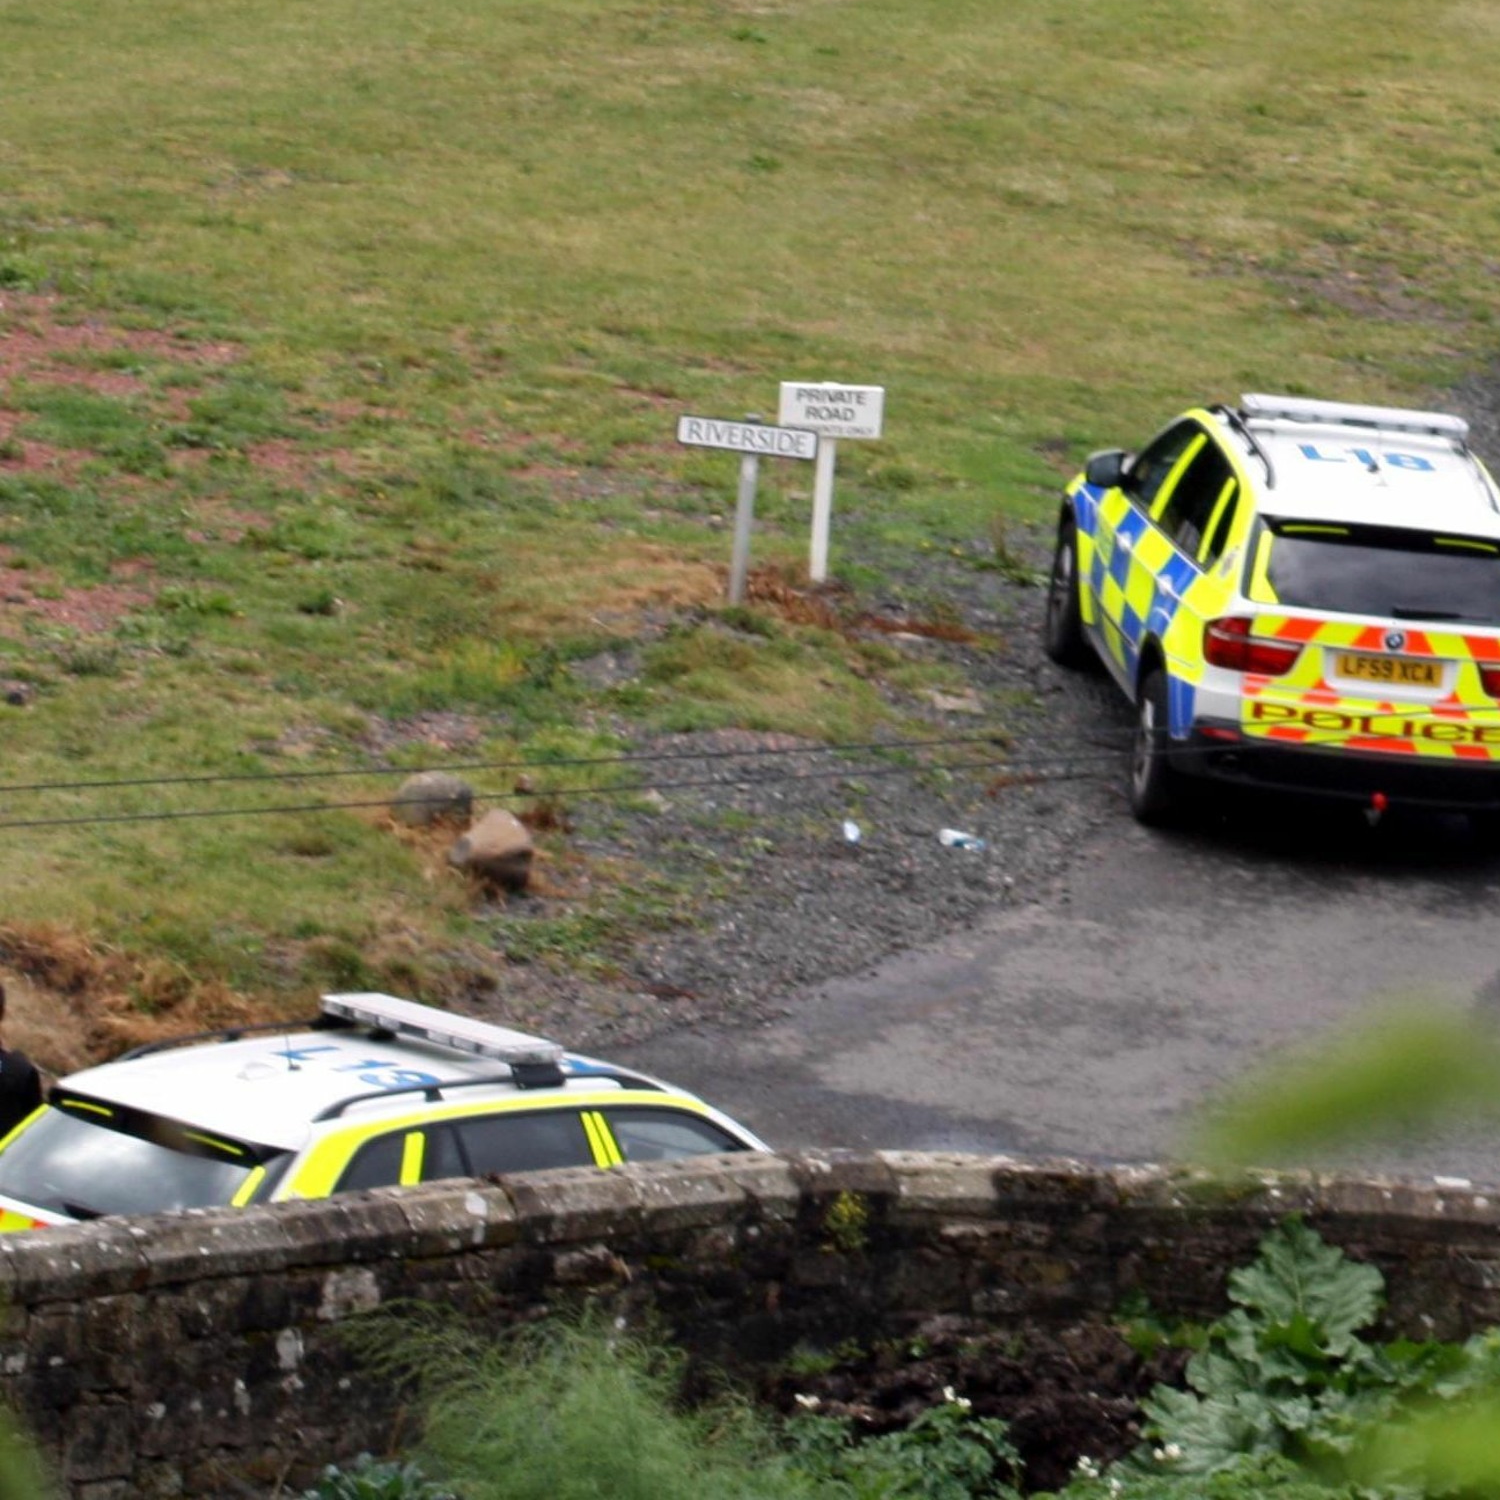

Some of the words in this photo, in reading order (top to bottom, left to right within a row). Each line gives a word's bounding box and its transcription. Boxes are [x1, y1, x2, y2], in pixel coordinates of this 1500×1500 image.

[797, 388, 867, 405] PRIVATE
[805, 406, 856, 421] ROAD
[688, 420, 807, 455] RIVERSIDE
